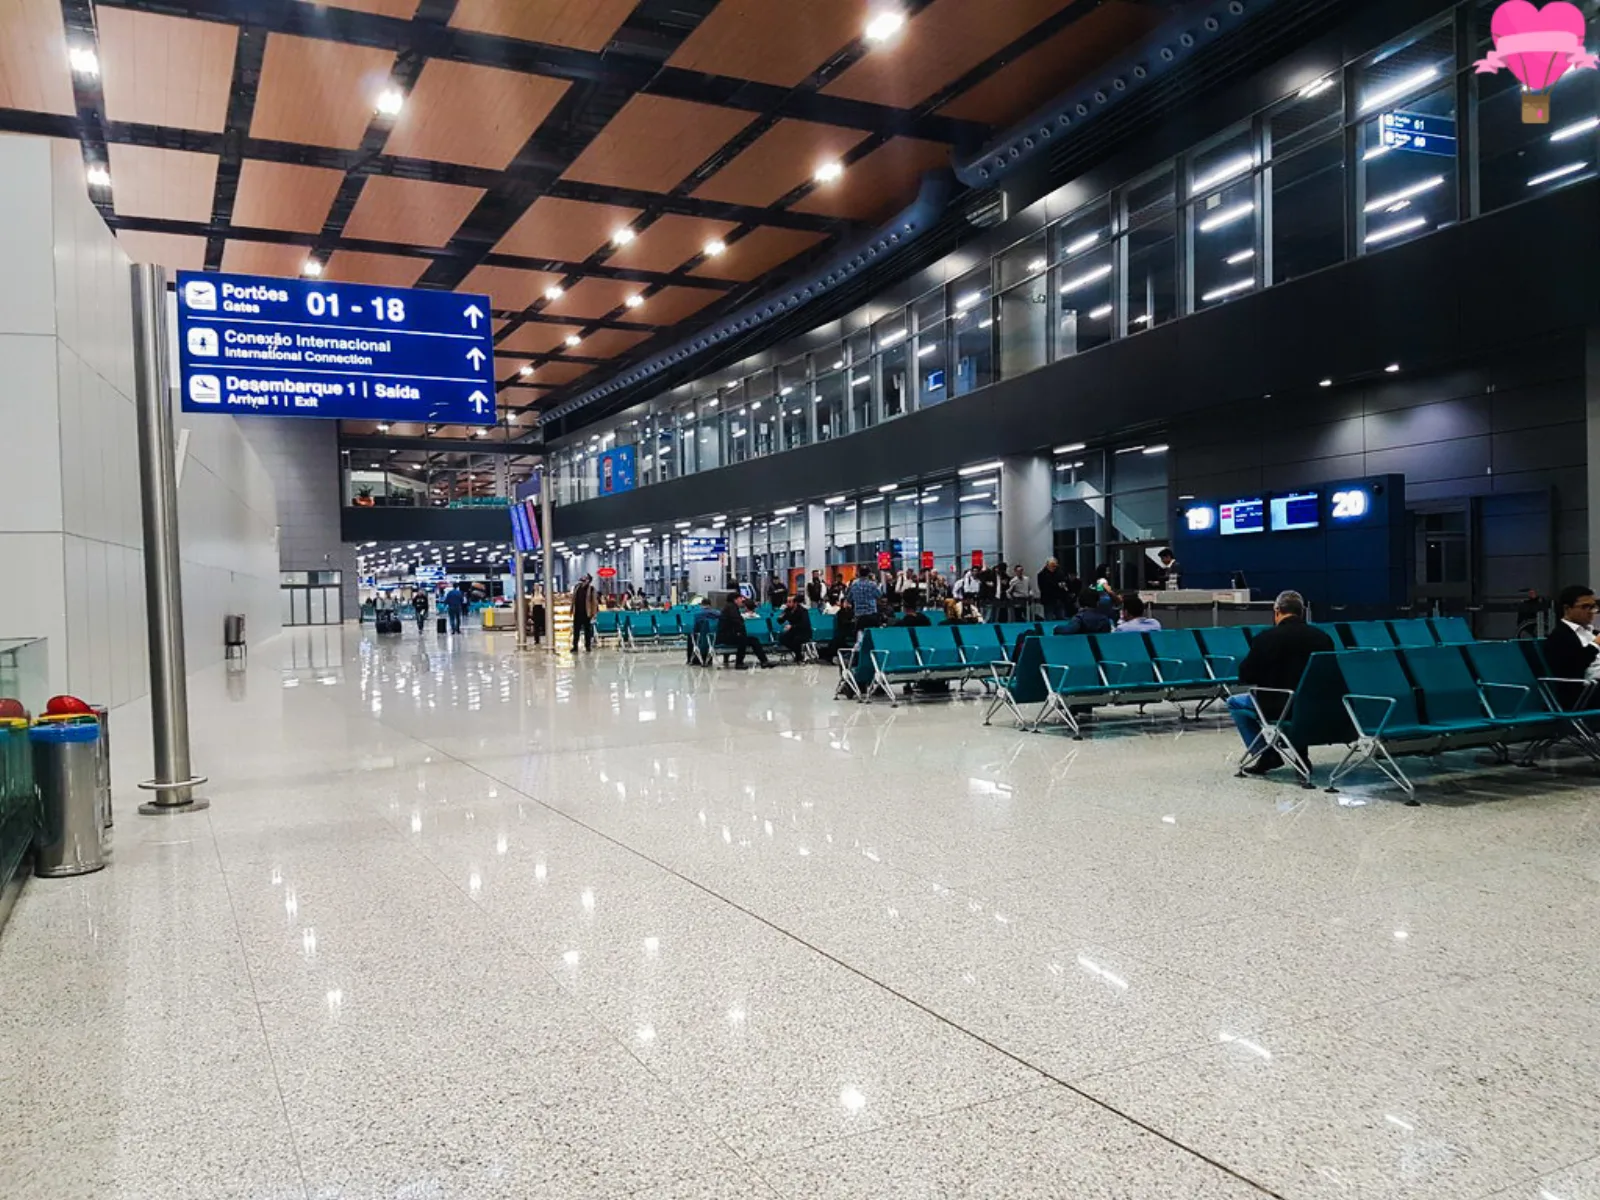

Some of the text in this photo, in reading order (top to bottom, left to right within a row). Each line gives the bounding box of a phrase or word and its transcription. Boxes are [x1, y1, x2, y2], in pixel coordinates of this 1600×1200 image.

[222, 282, 288, 302] Portões
[306, 291, 339, 318] 01
[371, 296, 405, 322] 18
[223, 300, 260, 314] Gates
[224, 329, 391, 352] Conexão Internacional
[225, 346, 373, 365] International Connection
[226, 376, 343, 397] Desembarque
[347, 382, 355, 396] 1
[374, 384, 420, 400] Saída
[228, 393, 269, 407] Arrival
[271, 395, 278, 405] 1
[295, 396, 318, 407] Exit
[1332, 490, 1368, 518] 20
